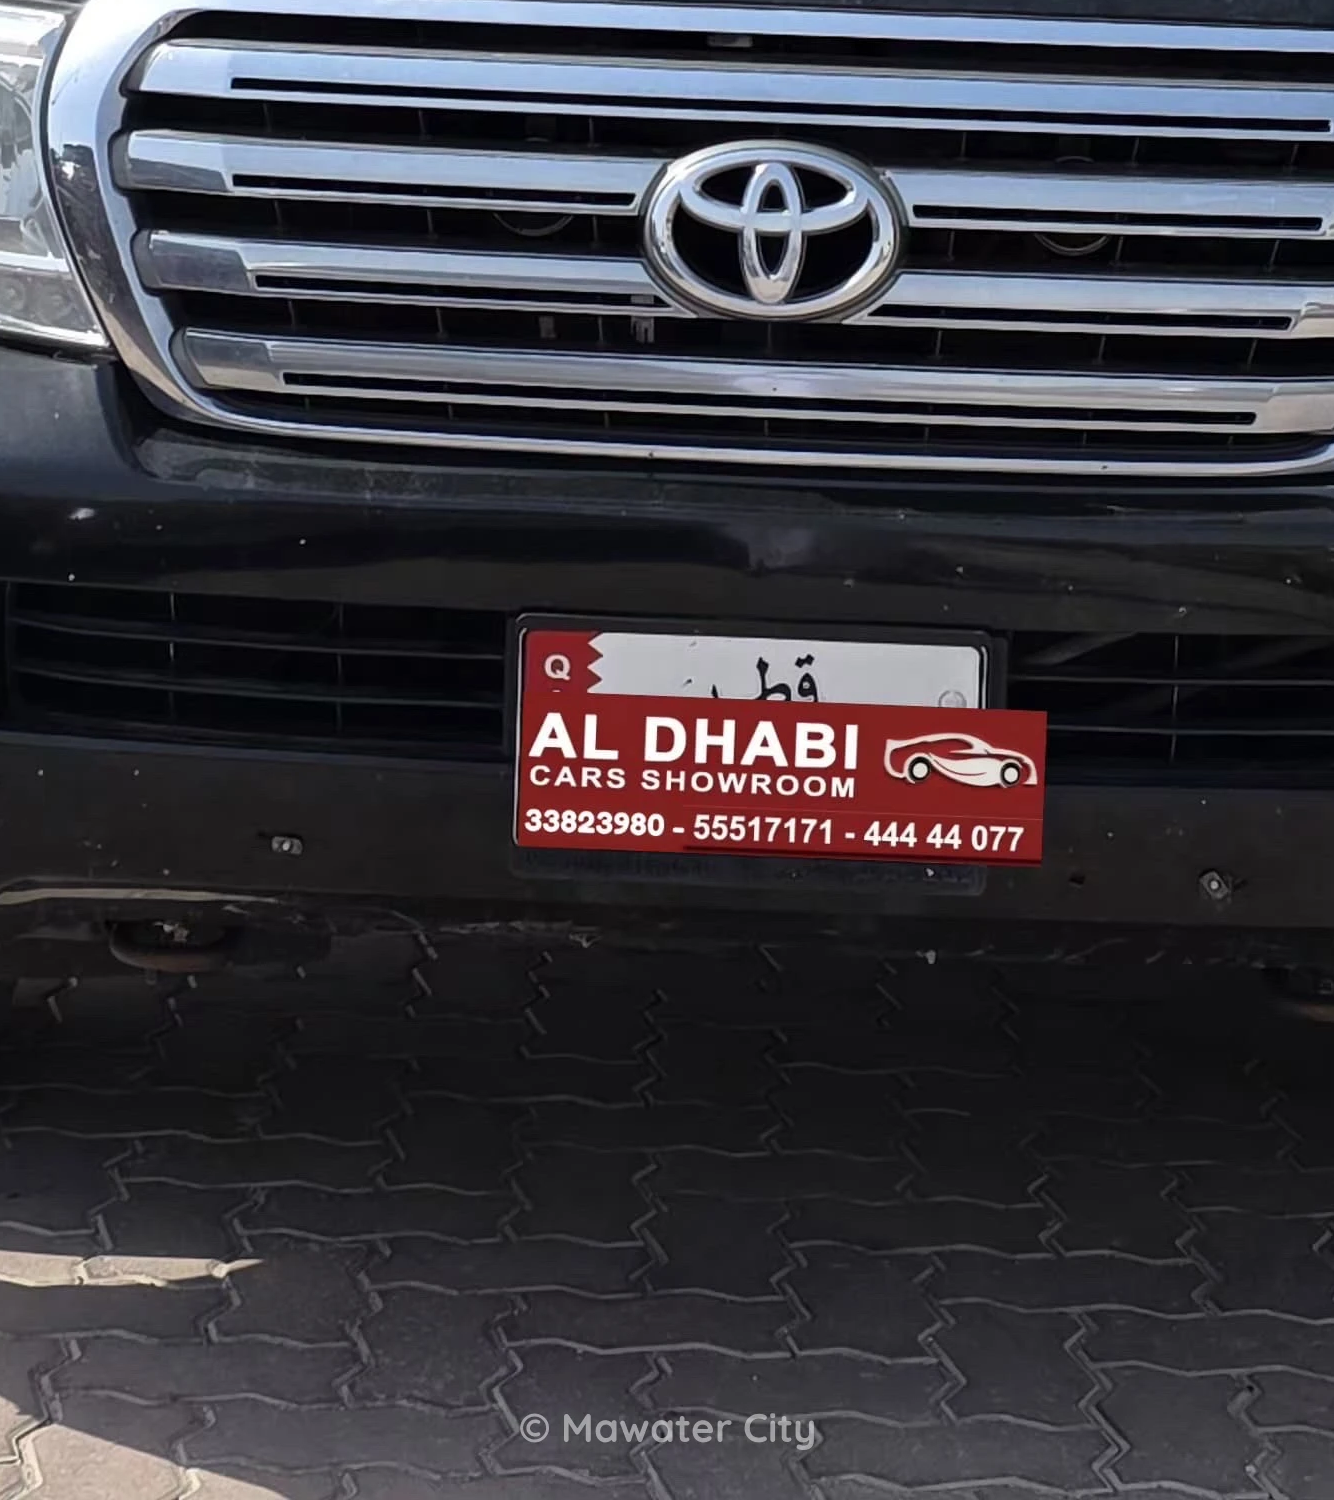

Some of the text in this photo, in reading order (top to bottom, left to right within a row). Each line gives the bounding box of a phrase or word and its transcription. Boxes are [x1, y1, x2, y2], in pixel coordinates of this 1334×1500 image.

[543, 654, 571, 682] Q
[528, 711, 859, 770] AL DHABI
[529, 765, 856, 798] CARS SHOWROOM
[524, 808, 666, 838] 33823980
[693, 814, 833, 845] 55517171
[863, 821, 917, 849] 444
[926, 823, 963, 851] 44
[971, 824, 1024, 852] 077
